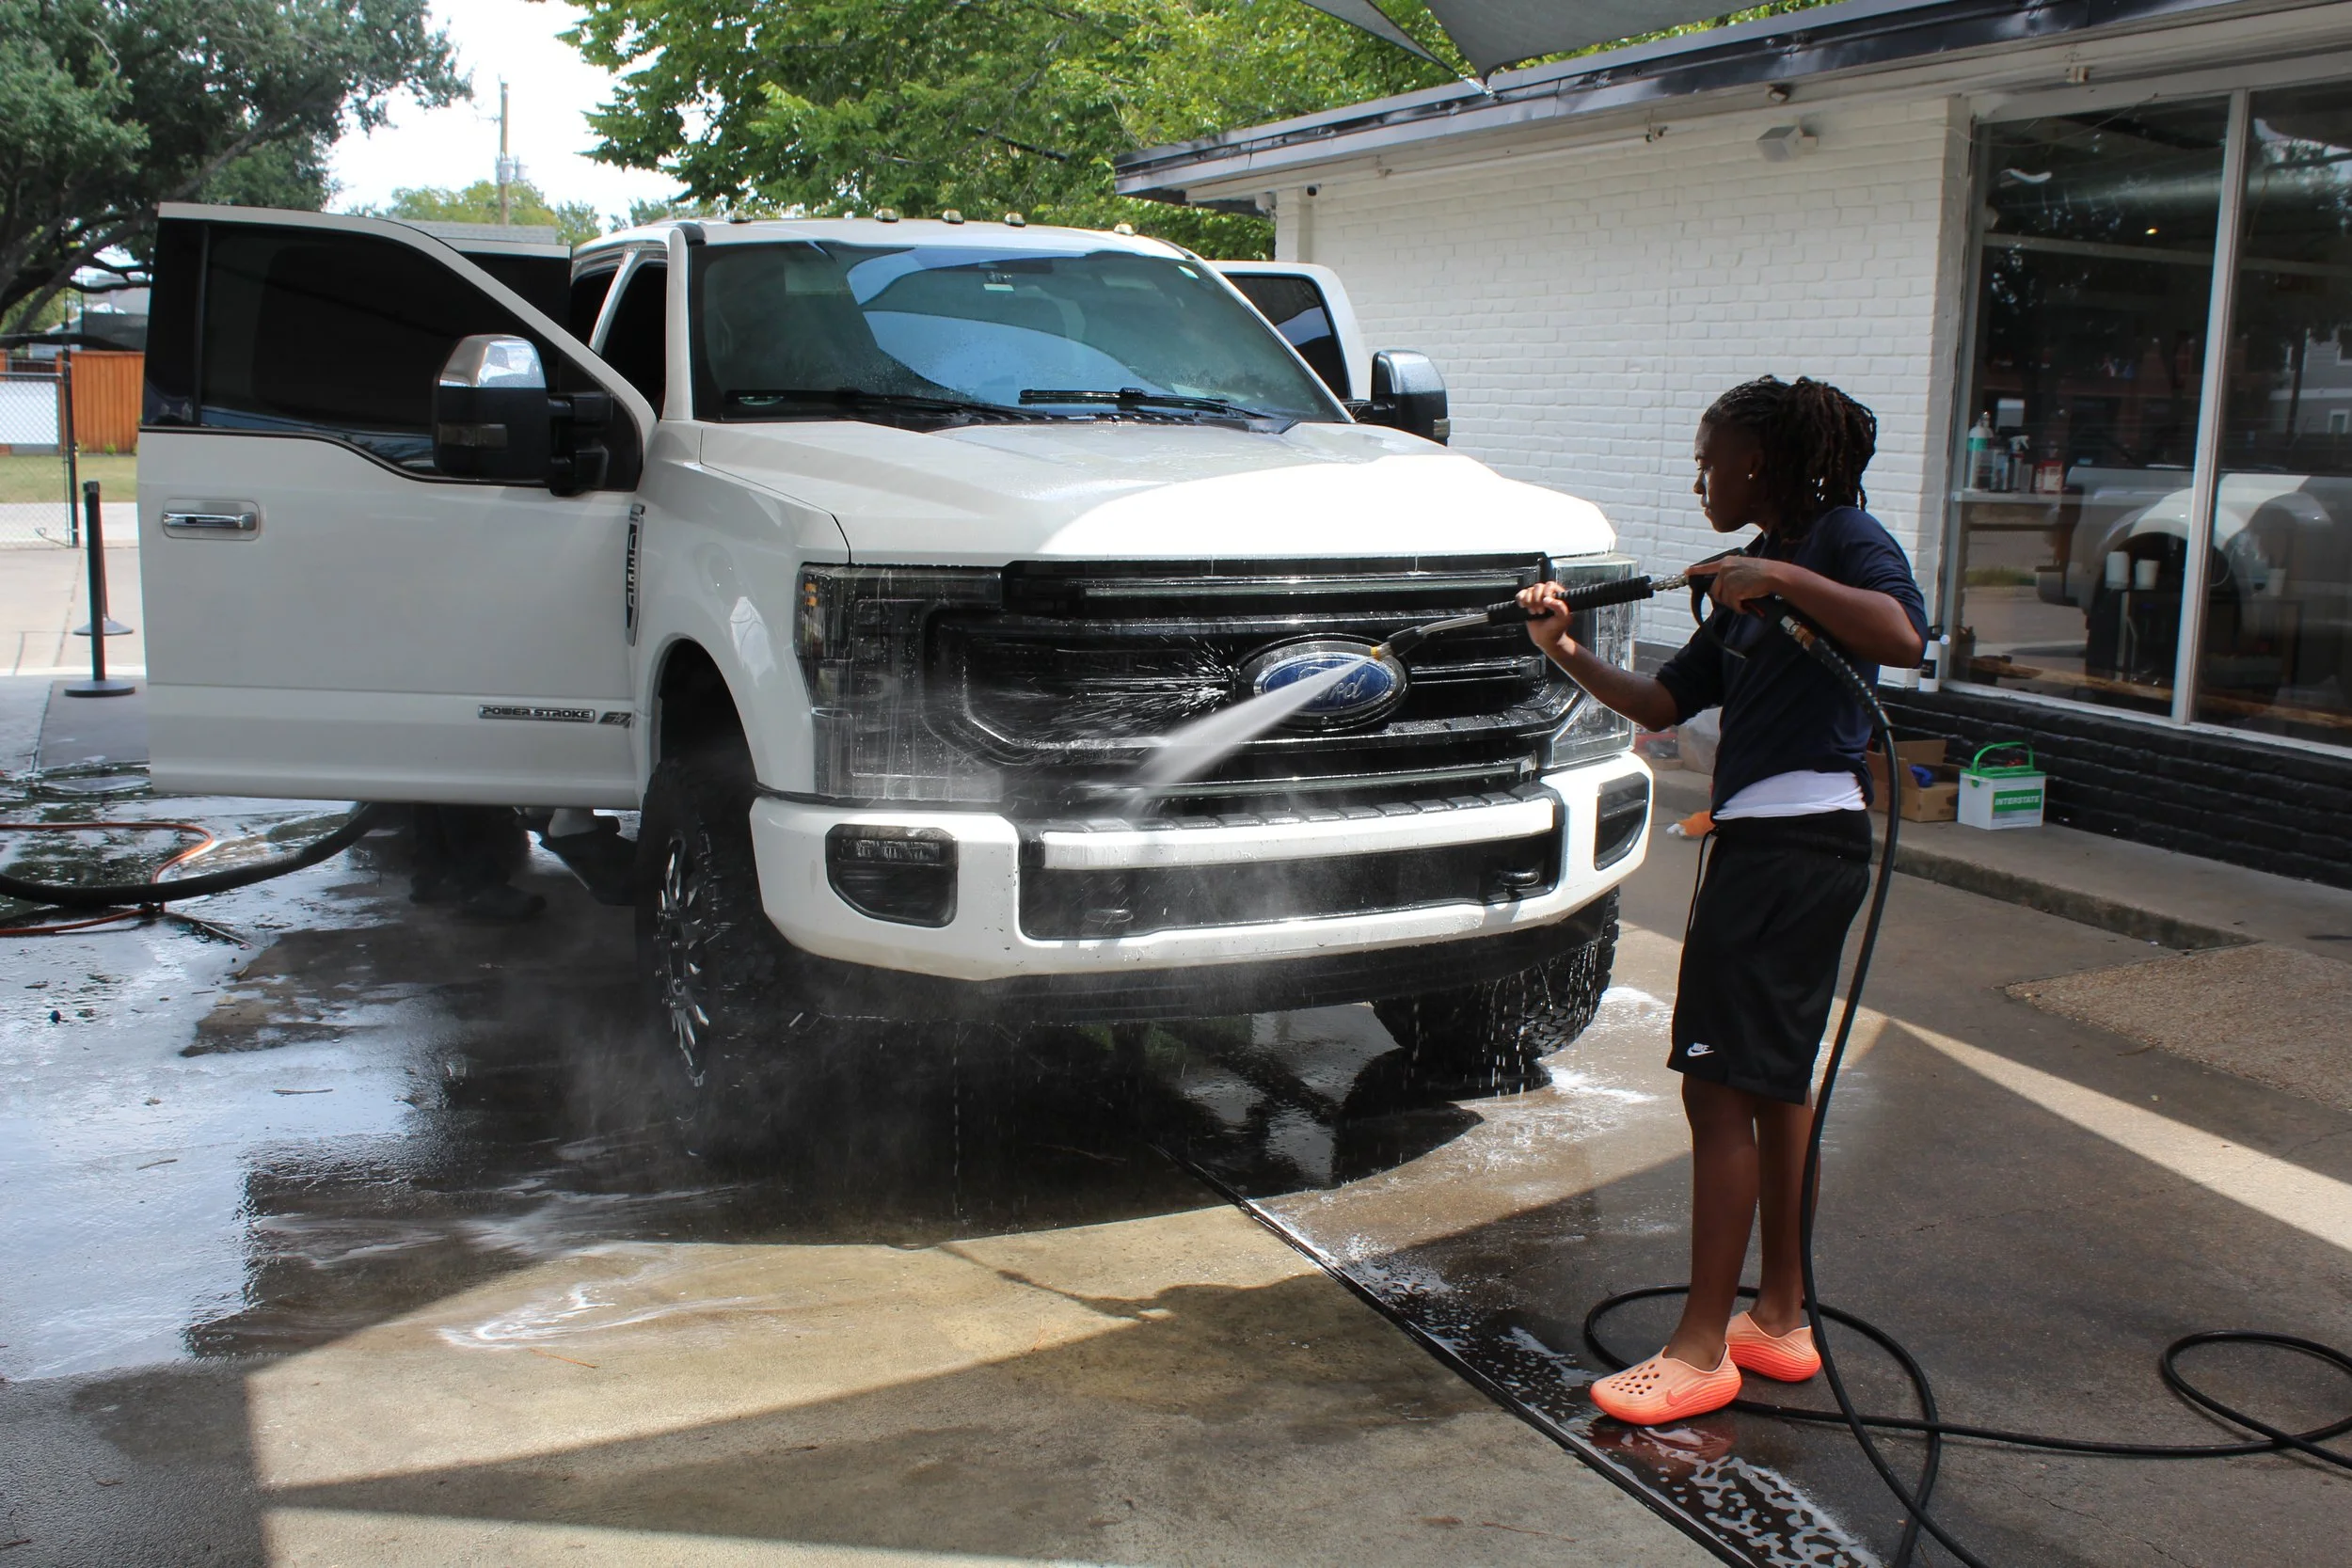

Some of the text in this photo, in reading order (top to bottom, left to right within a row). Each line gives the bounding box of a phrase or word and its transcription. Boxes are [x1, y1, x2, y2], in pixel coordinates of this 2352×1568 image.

[483, 706, 590, 719] POWER STROKE
[1994, 795, 2040, 806] INTERSTATE
